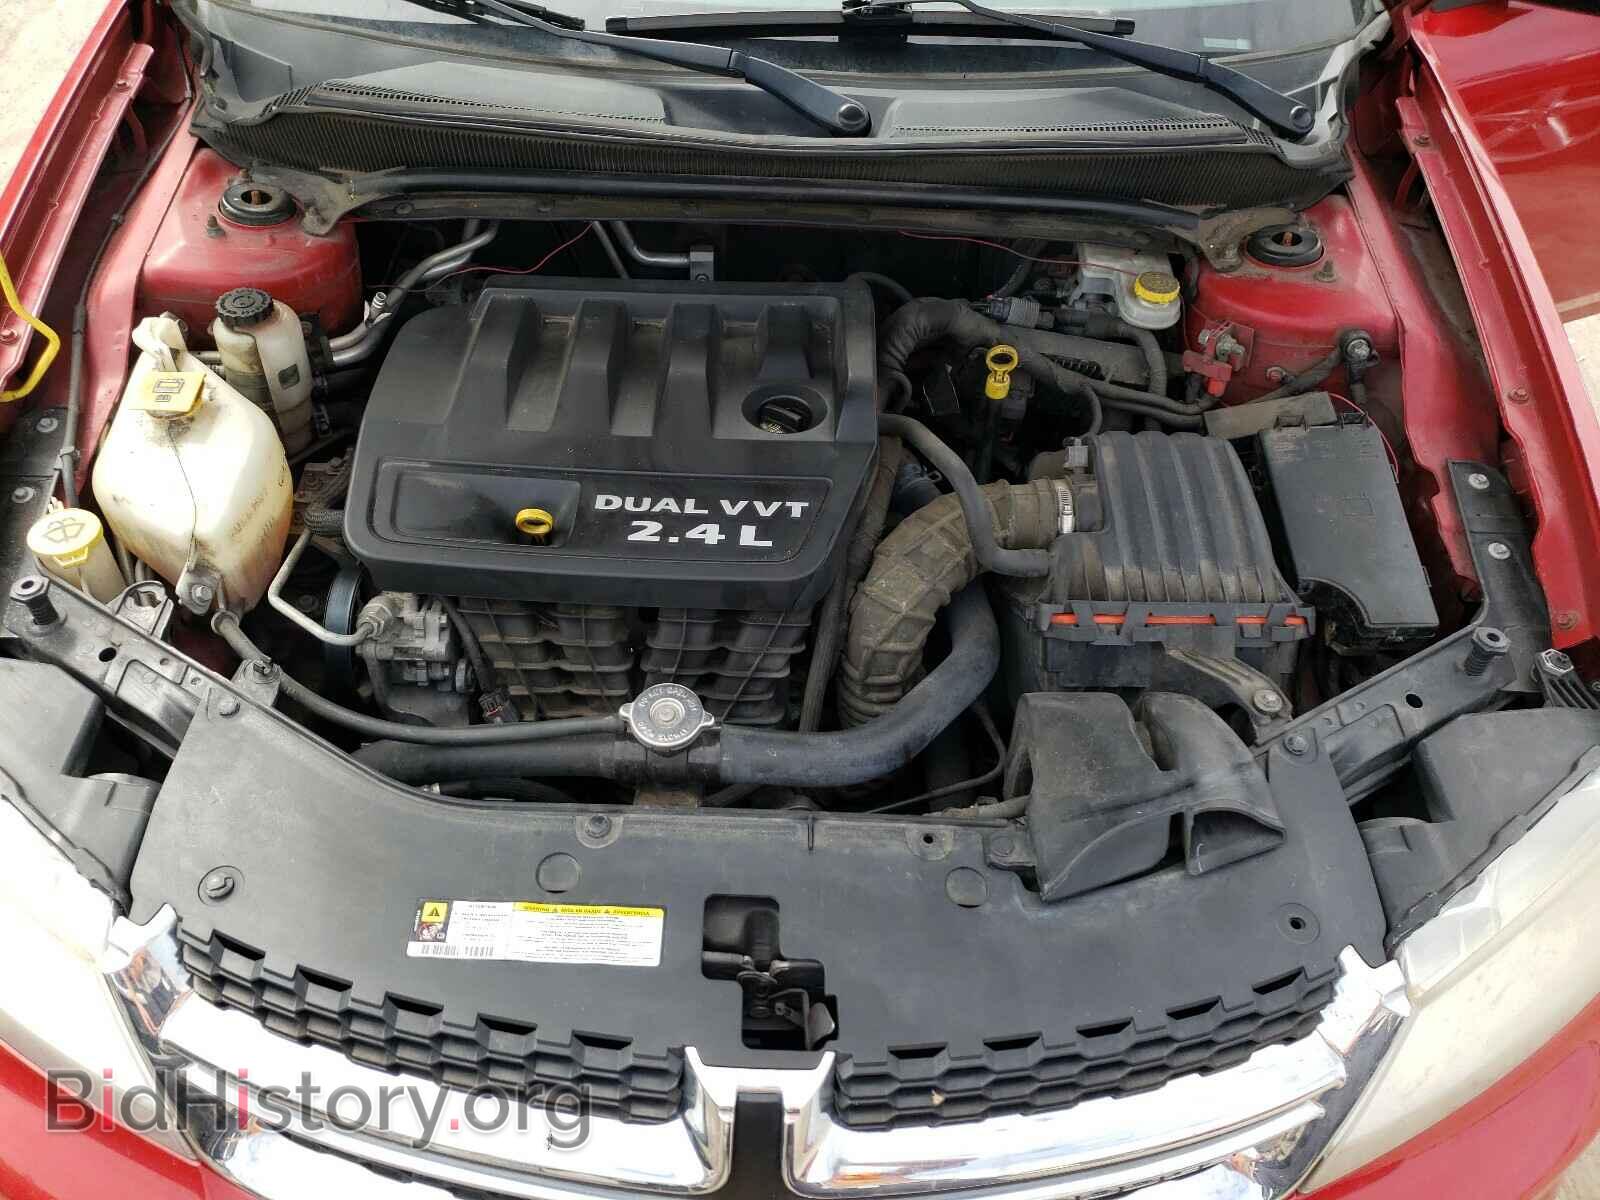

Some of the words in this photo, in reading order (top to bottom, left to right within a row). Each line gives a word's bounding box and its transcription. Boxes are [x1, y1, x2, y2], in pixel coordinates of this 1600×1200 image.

[594, 494, 709, 514] DUAL
[719, 499, 809, 518] VVT
[627, 520, 726, 545] 2.4
[739, 525, 773, 547] L
